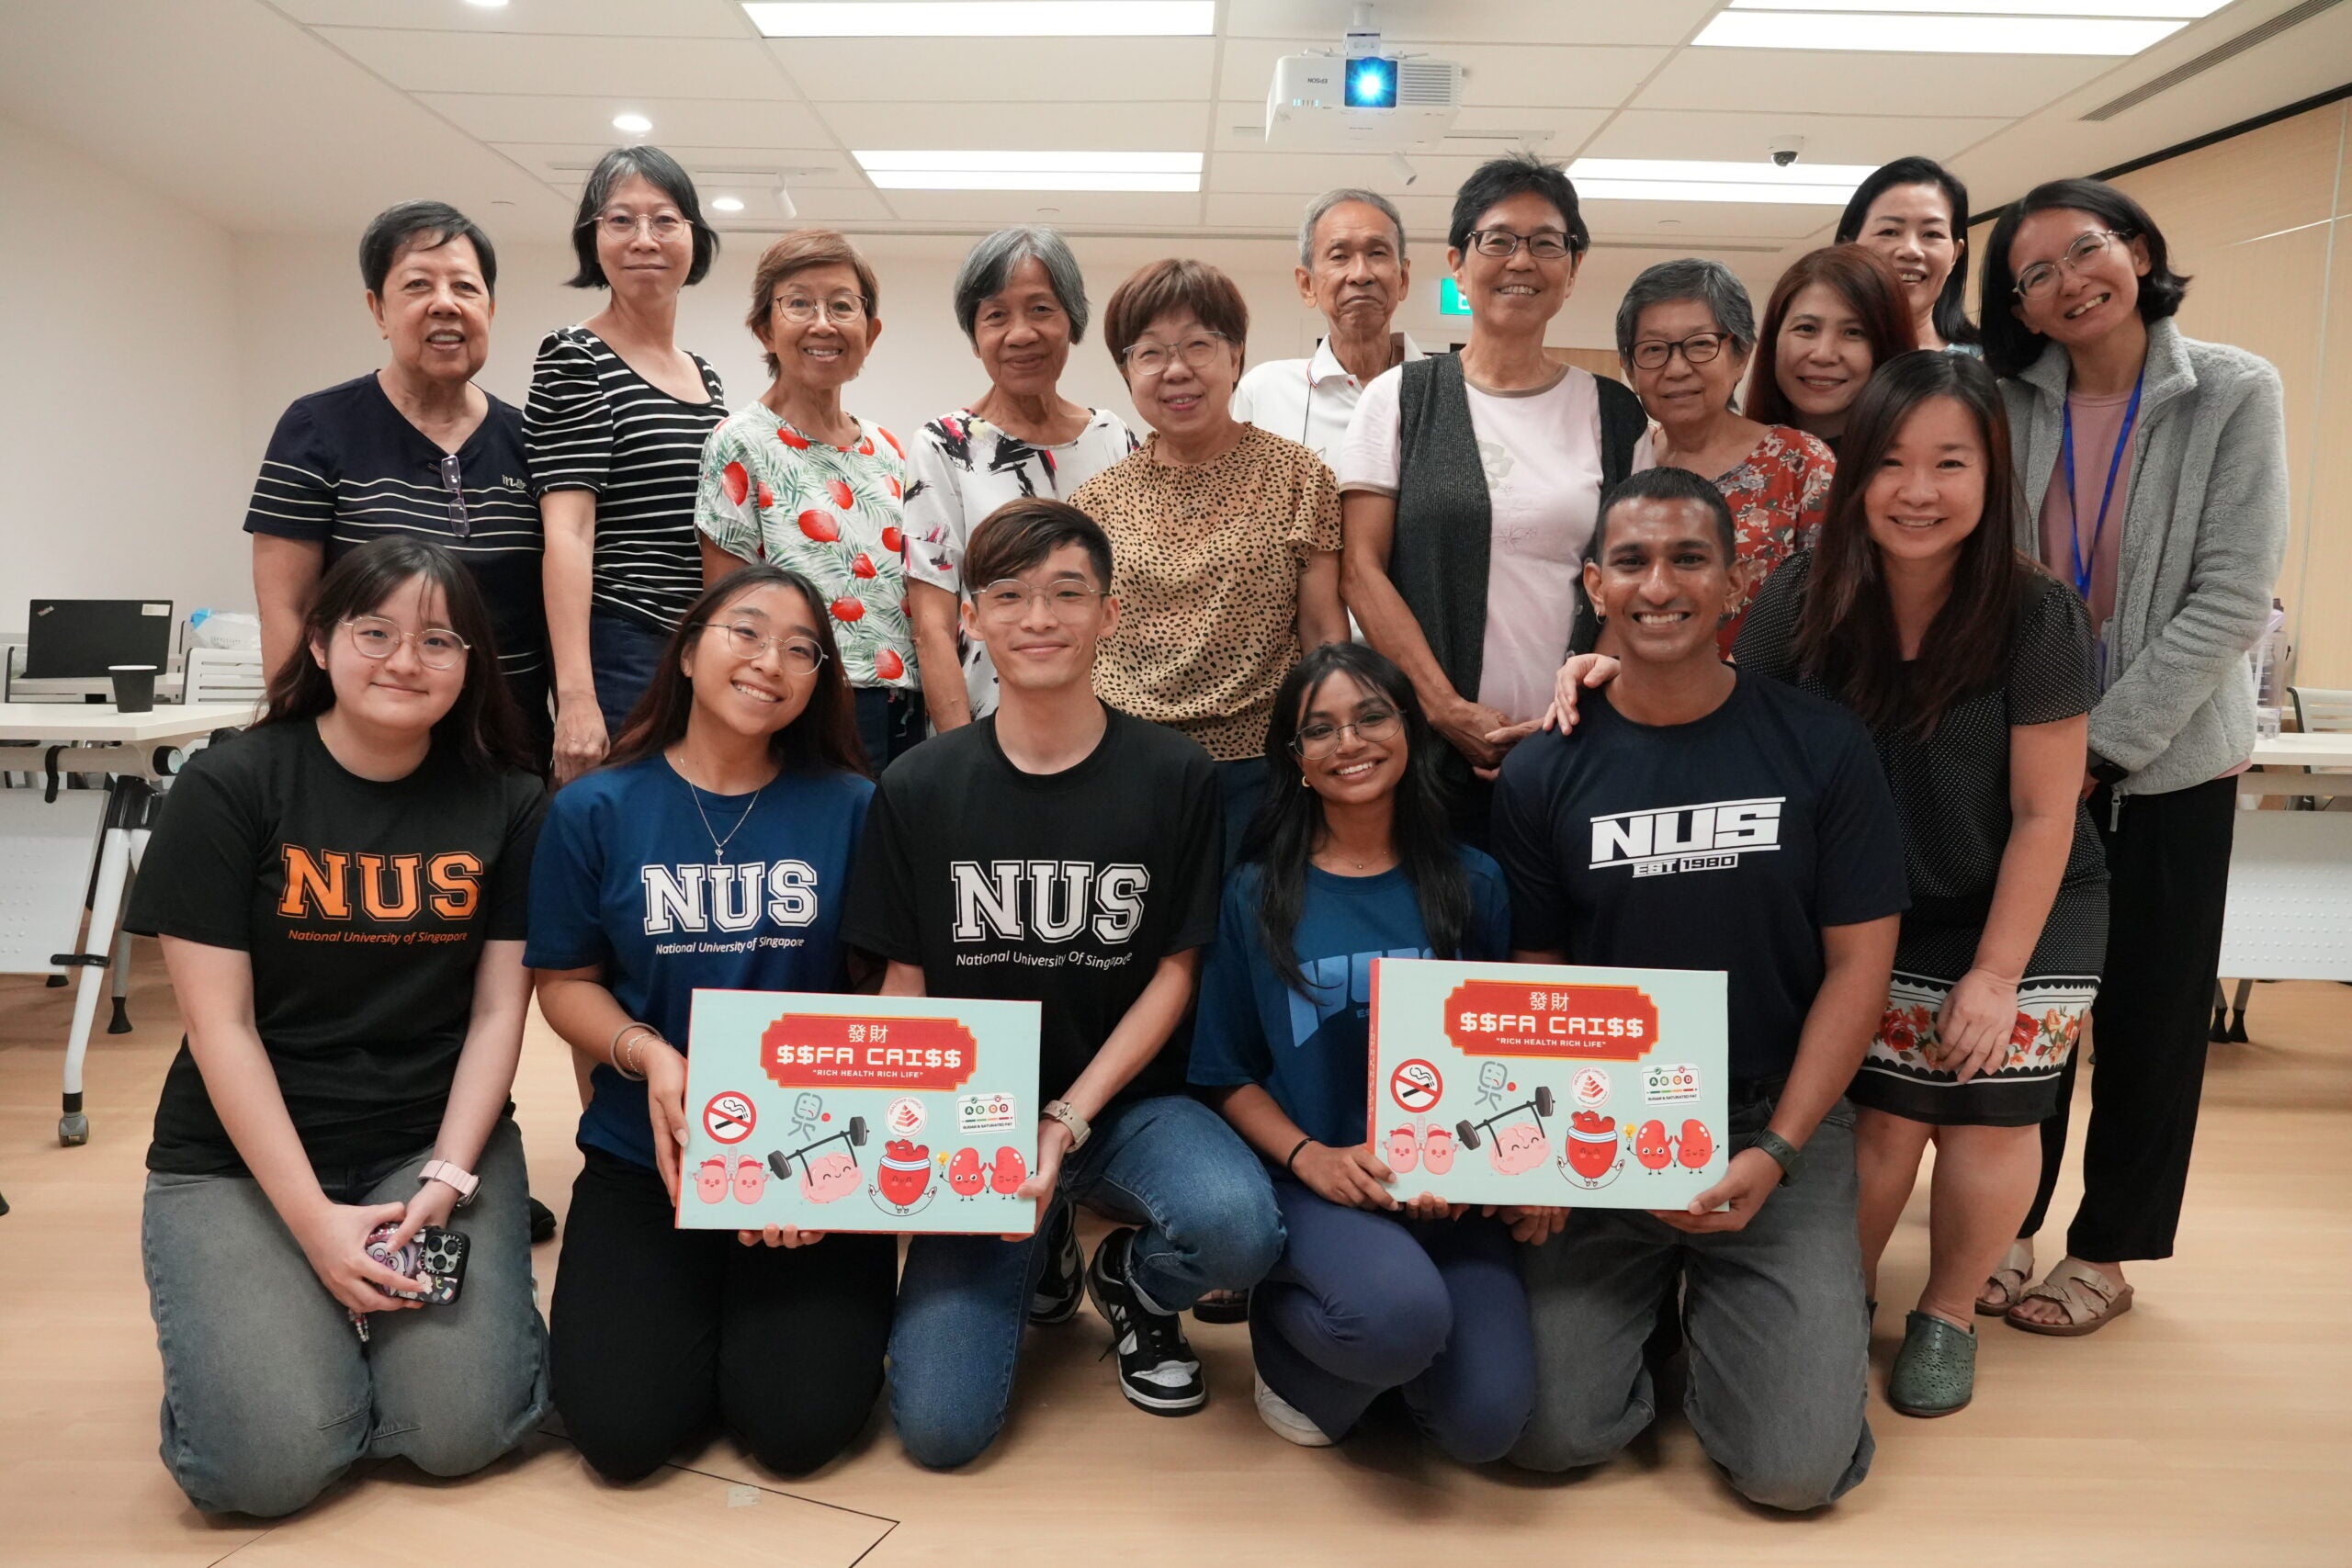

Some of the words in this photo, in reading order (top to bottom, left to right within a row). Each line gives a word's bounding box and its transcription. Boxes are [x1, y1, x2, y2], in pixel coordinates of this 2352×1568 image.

[1590, 798, 1785, 868] NUS
[1633, 859, 1677, 877] EST
[1682, 855, 1736, 870] 1980
[277, 843, 483, 921] NUS
[641, 859, 818, 936] NUS
[951, 860, 1150, 944] NUS
[288, 930, 341, 942] National
[344, 931, 401, 945] University
[403, 932, 417, 944] of
[416, 931, 468, 944] Singapore
[656, 942, 696, 955] National
[698, 941, 747, 953] University
[746, 937, 758, 952] of
[759, 936, 805, 949] Singapore
[956, 950, 1011, 966] National
[1012, 951, 1067, 967] University
[1069, 951, 1086, 965] Of
[1529, 991, 1570, 1012] 發財
[848, 1023, 889, 1043] 發財
[1460, 1011, 1536, 1033] $$FA
[1548, 1016, 1645, 1038] CAI$$
[1523, 1038, 1557, 1046] HEALTH
[1583, 1040, 1607, 1048] LIFE"
[776, 1044, 854, 1066] $$FA
[866, 1048, 962, 1069] CAI$$
[877, 1070, 898, 1078] RICH
